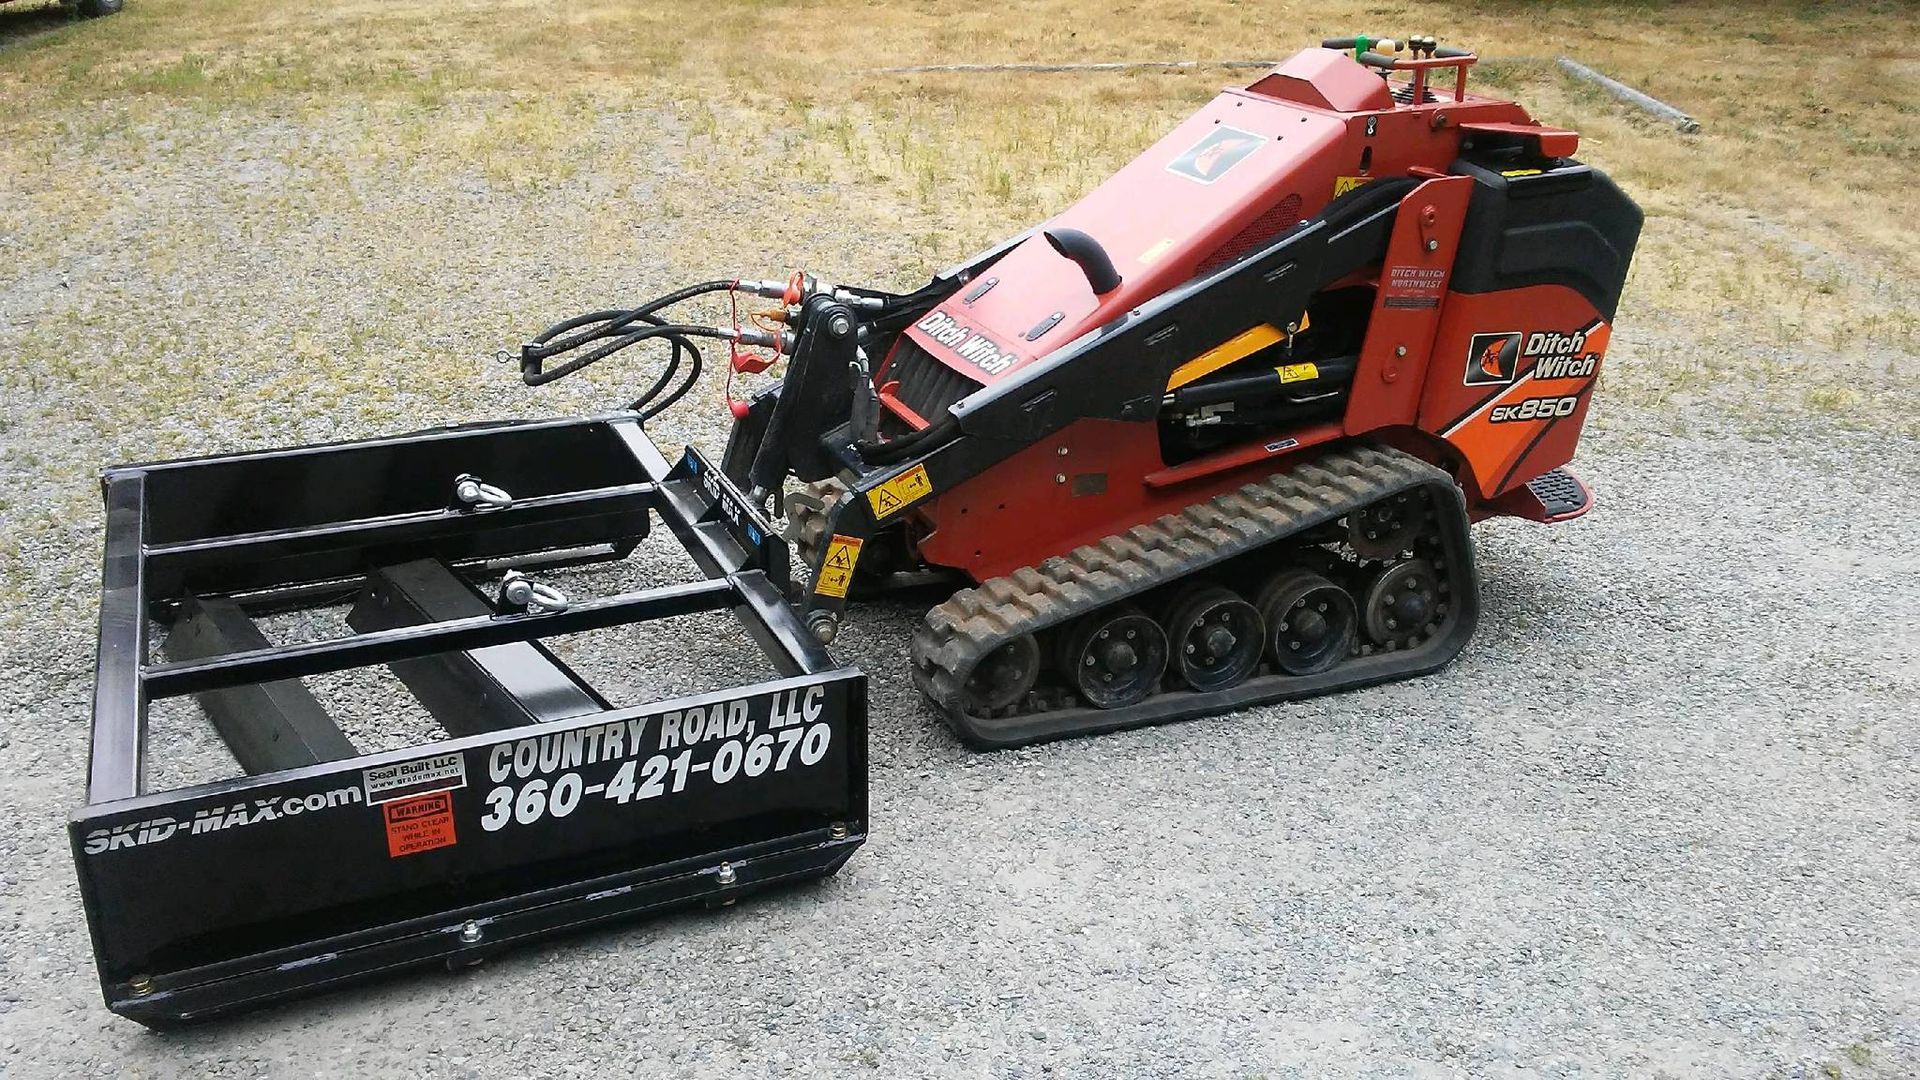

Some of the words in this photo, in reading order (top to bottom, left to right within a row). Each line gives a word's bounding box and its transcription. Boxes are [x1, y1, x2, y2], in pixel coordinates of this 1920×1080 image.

[917, 310, 969, 347] Ditch
[956, 334, 1015, 376] Witch
[1524, 331, 1586, 356] Ditch
[1534, 355, 1597, 379] Witch
[1490, 397, 1578, 422] SK850
[489, 716, 649, 784] COUNTRY
[658, 699, 757, 751] ROAD,
[769, 684, 826, 729] LLC
[369, 767, 397, 782] Seal
[400, 761, 430, 776] Built
[433, 756, 457, 769] LLC
[480, 722, 832, 832] 360-421-0670
[84, 785, 363, 856] SKID-MAX.com
[396, 800, 441, 817] WARNING
[391, 823, 419, 833] STAND
[421, 816, 449, 828] CLEAR
[399, 836, 446, 852] OPERATION
